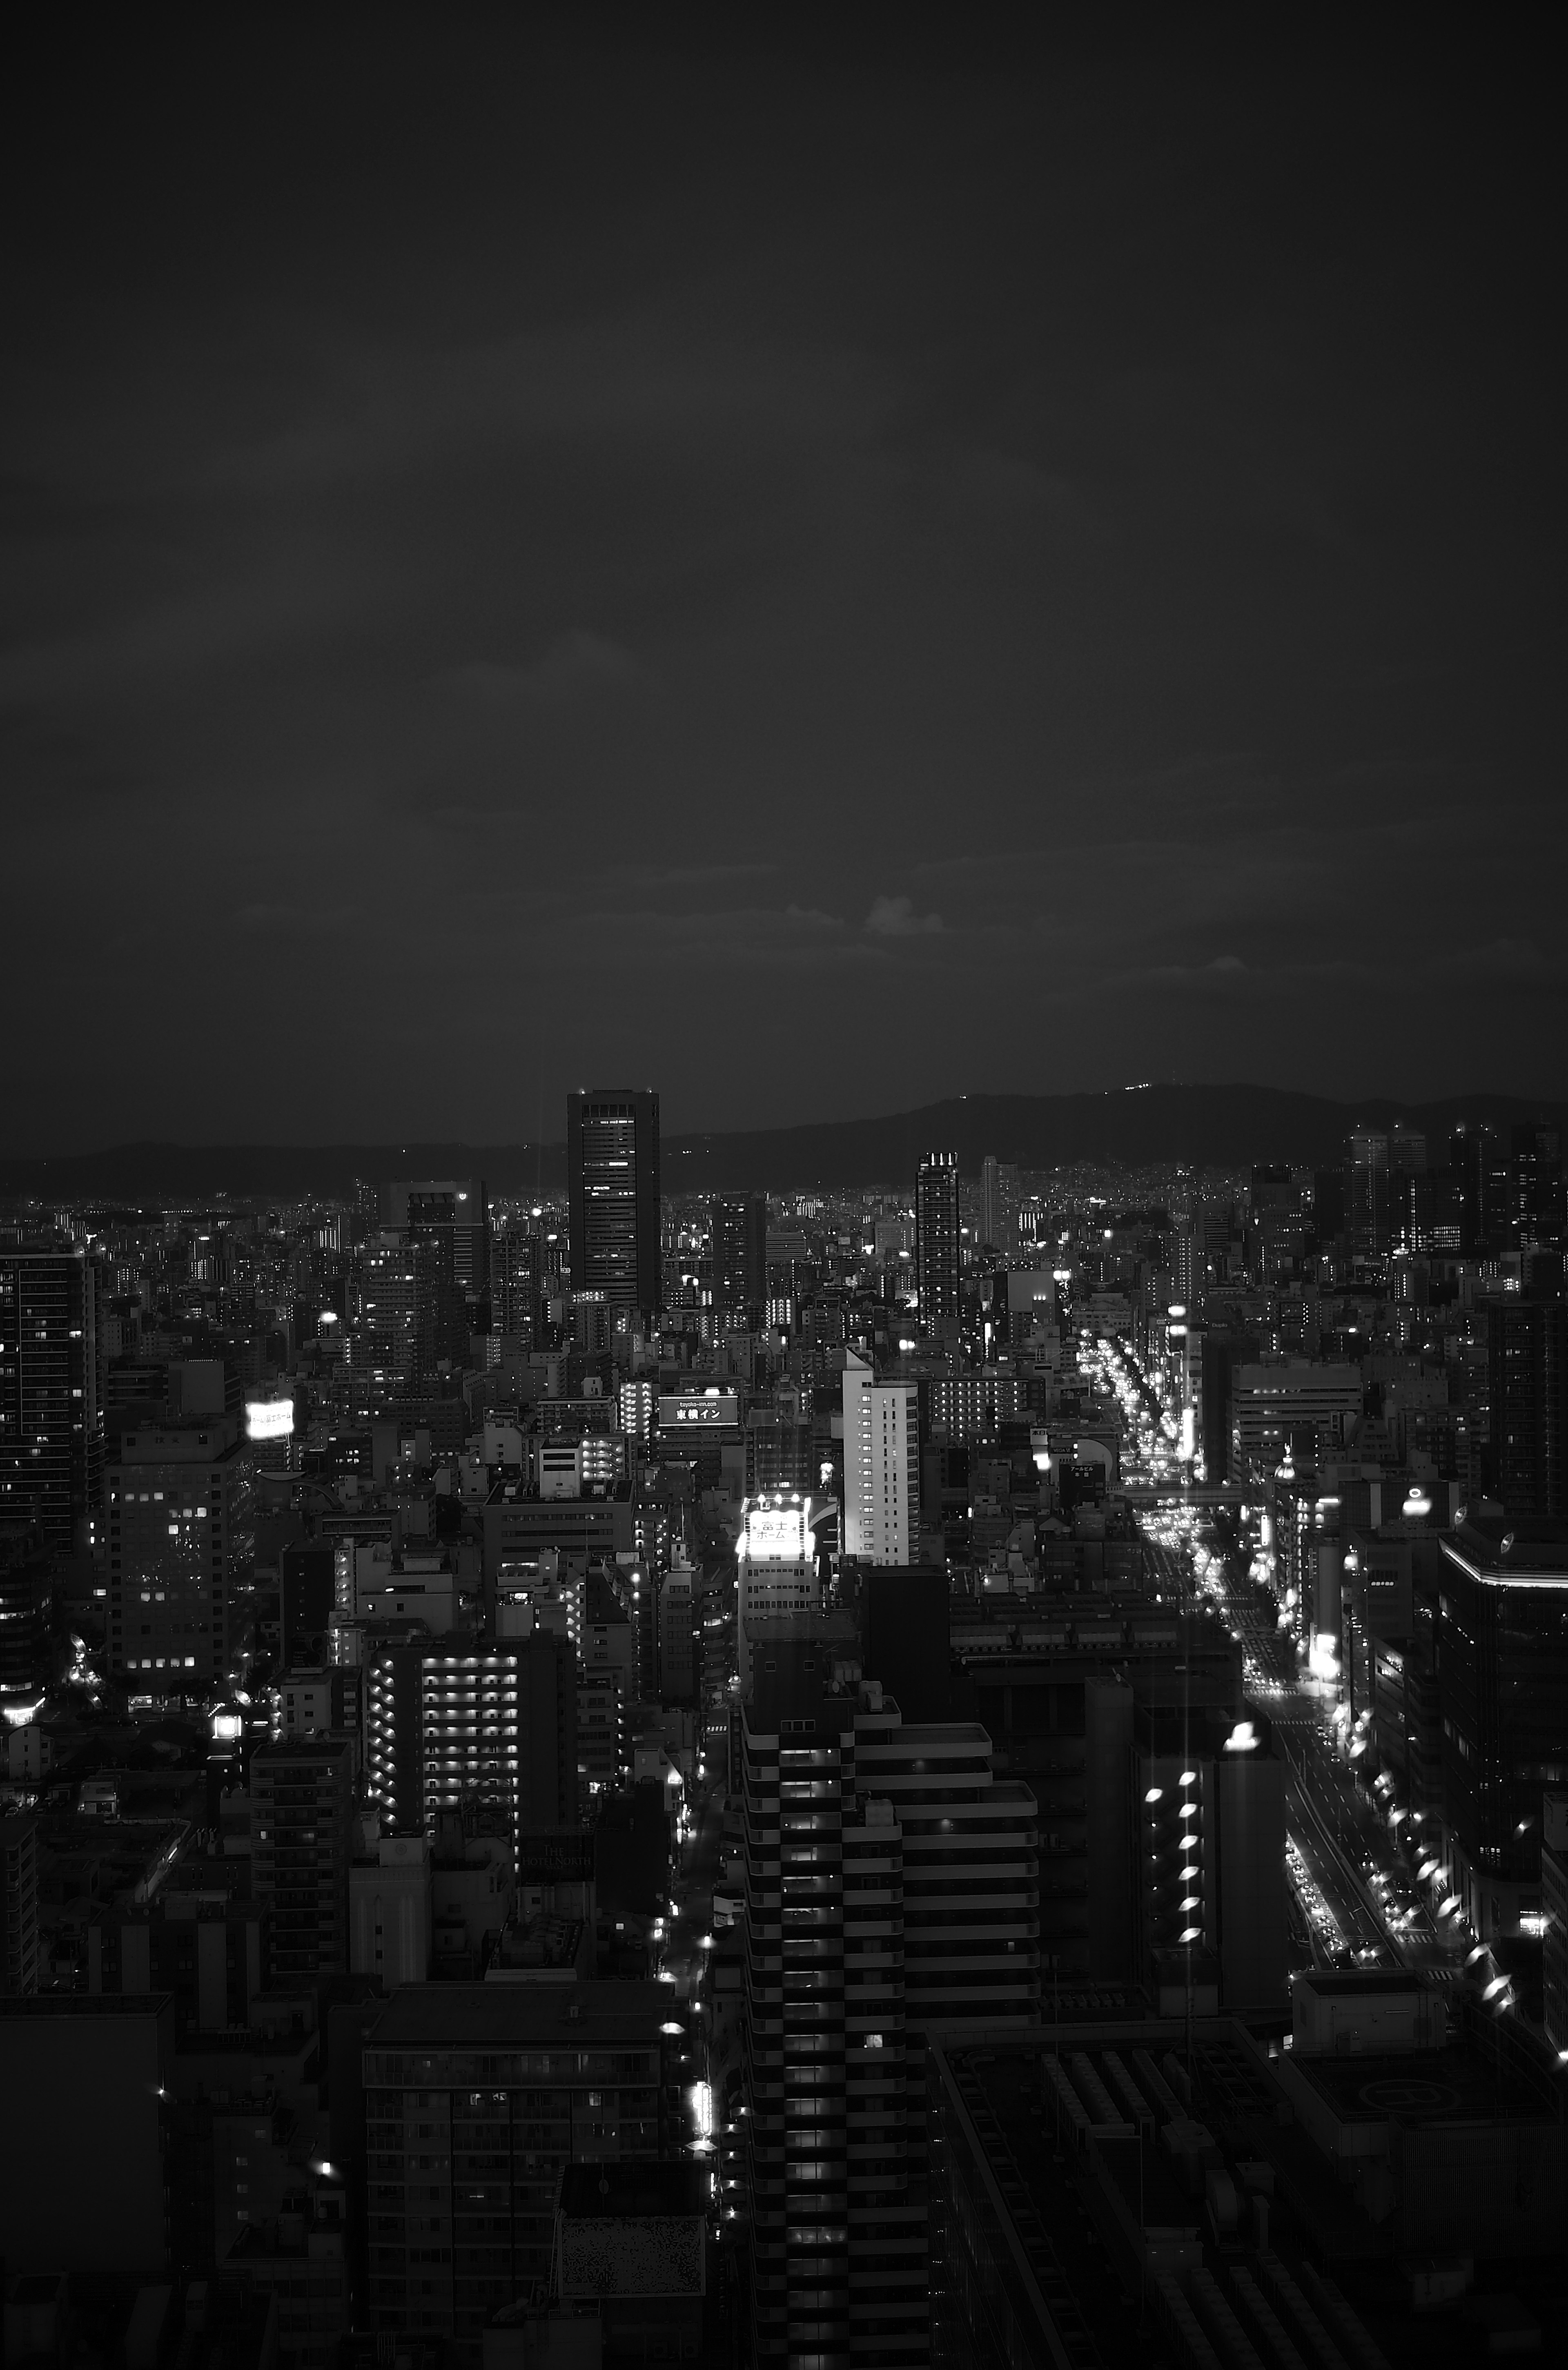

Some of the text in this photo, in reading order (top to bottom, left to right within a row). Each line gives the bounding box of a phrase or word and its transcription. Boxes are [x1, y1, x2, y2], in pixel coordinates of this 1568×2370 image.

[676, 1409, 720, 1420] 東横イン
[762, 1521, 788, 1530] 富士
[757, 1531, 785, 1539] ホーム
[544, 1844, 564, 1856] THE
